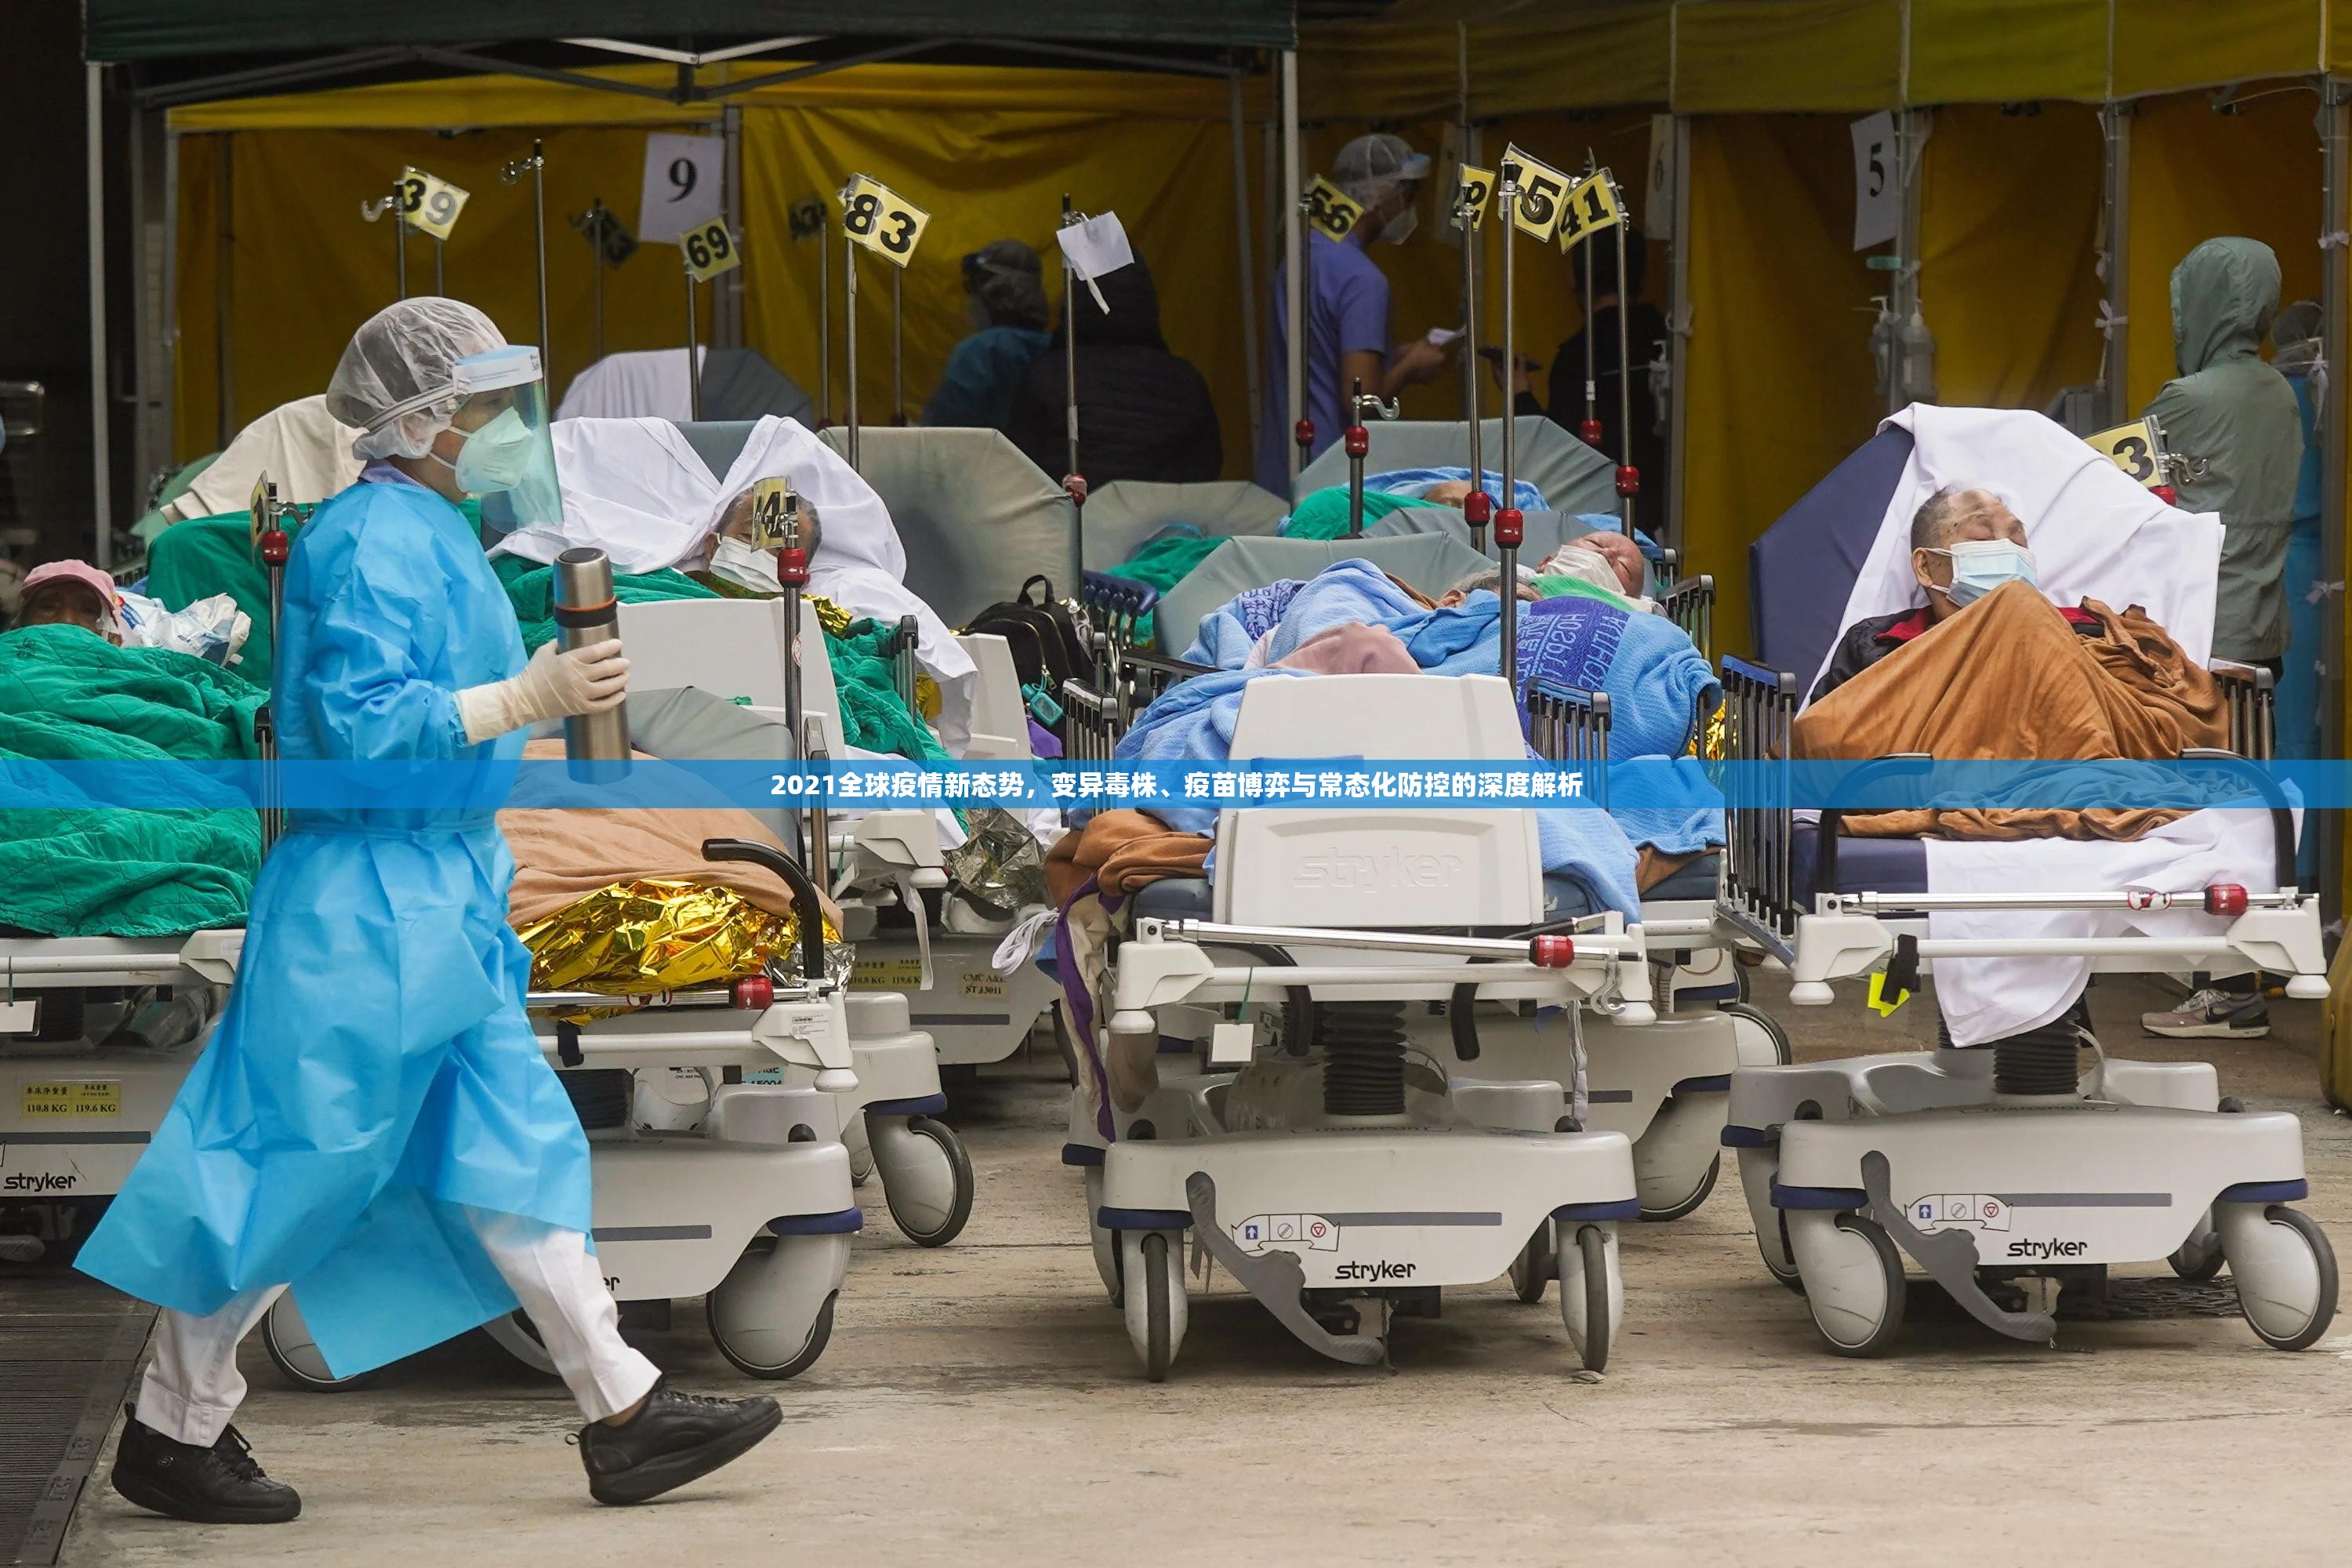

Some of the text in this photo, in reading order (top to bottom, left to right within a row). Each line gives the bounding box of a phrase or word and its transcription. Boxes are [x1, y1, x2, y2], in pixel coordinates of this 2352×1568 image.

[666, 159, 699, 203] 9
[1869, 143, 1885, 198] 5
[404, 179, 458, 225] 39
[1308, 186, 1356, 234] 56
[1504, 163, 1562, 224] 5
[1560, 185, 1610, 238] 41
[846, 194, 916, 254] 83
[688, 226, 729, 268] 69
[1292, 847, 1461, 894] stryker
[27, 1104, 67, 1112] 110.8 KG
[76, 1104, 116, 1112] 119.6 KG
[4, 1172, 76, 1192] stryker
[1335, 1260, 1416, 1282] stryker
[2007, 1238, 2087, 1259] stryker
